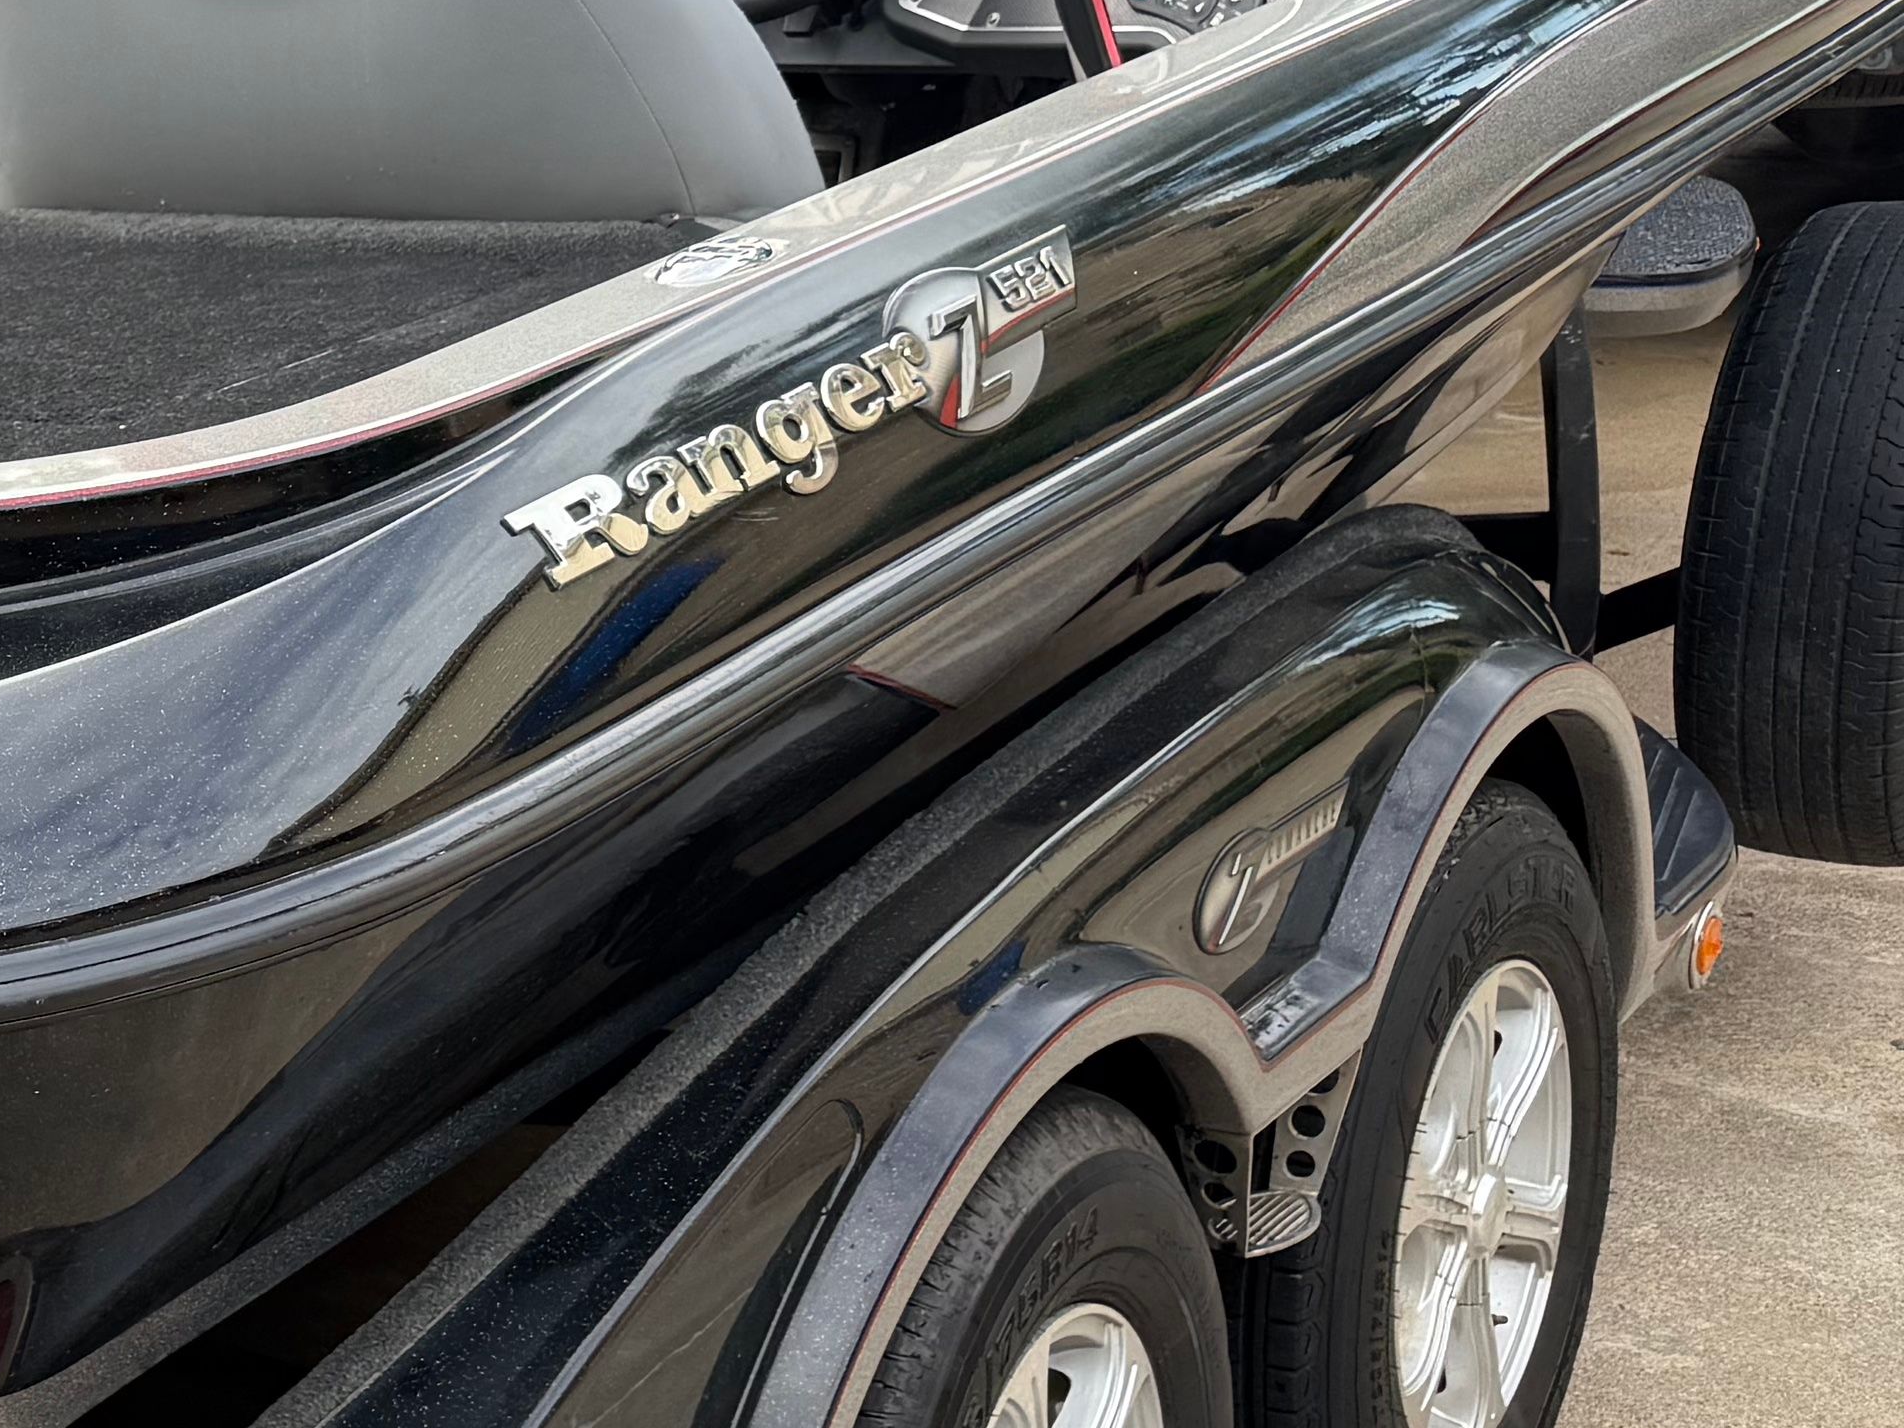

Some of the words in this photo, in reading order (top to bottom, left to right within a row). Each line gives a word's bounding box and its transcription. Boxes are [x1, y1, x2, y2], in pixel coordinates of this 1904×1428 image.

[500, 329, 930, 592] Ranger
[927, 294, 1014, 422] Z
[989, 245, 1071, 311] 521
